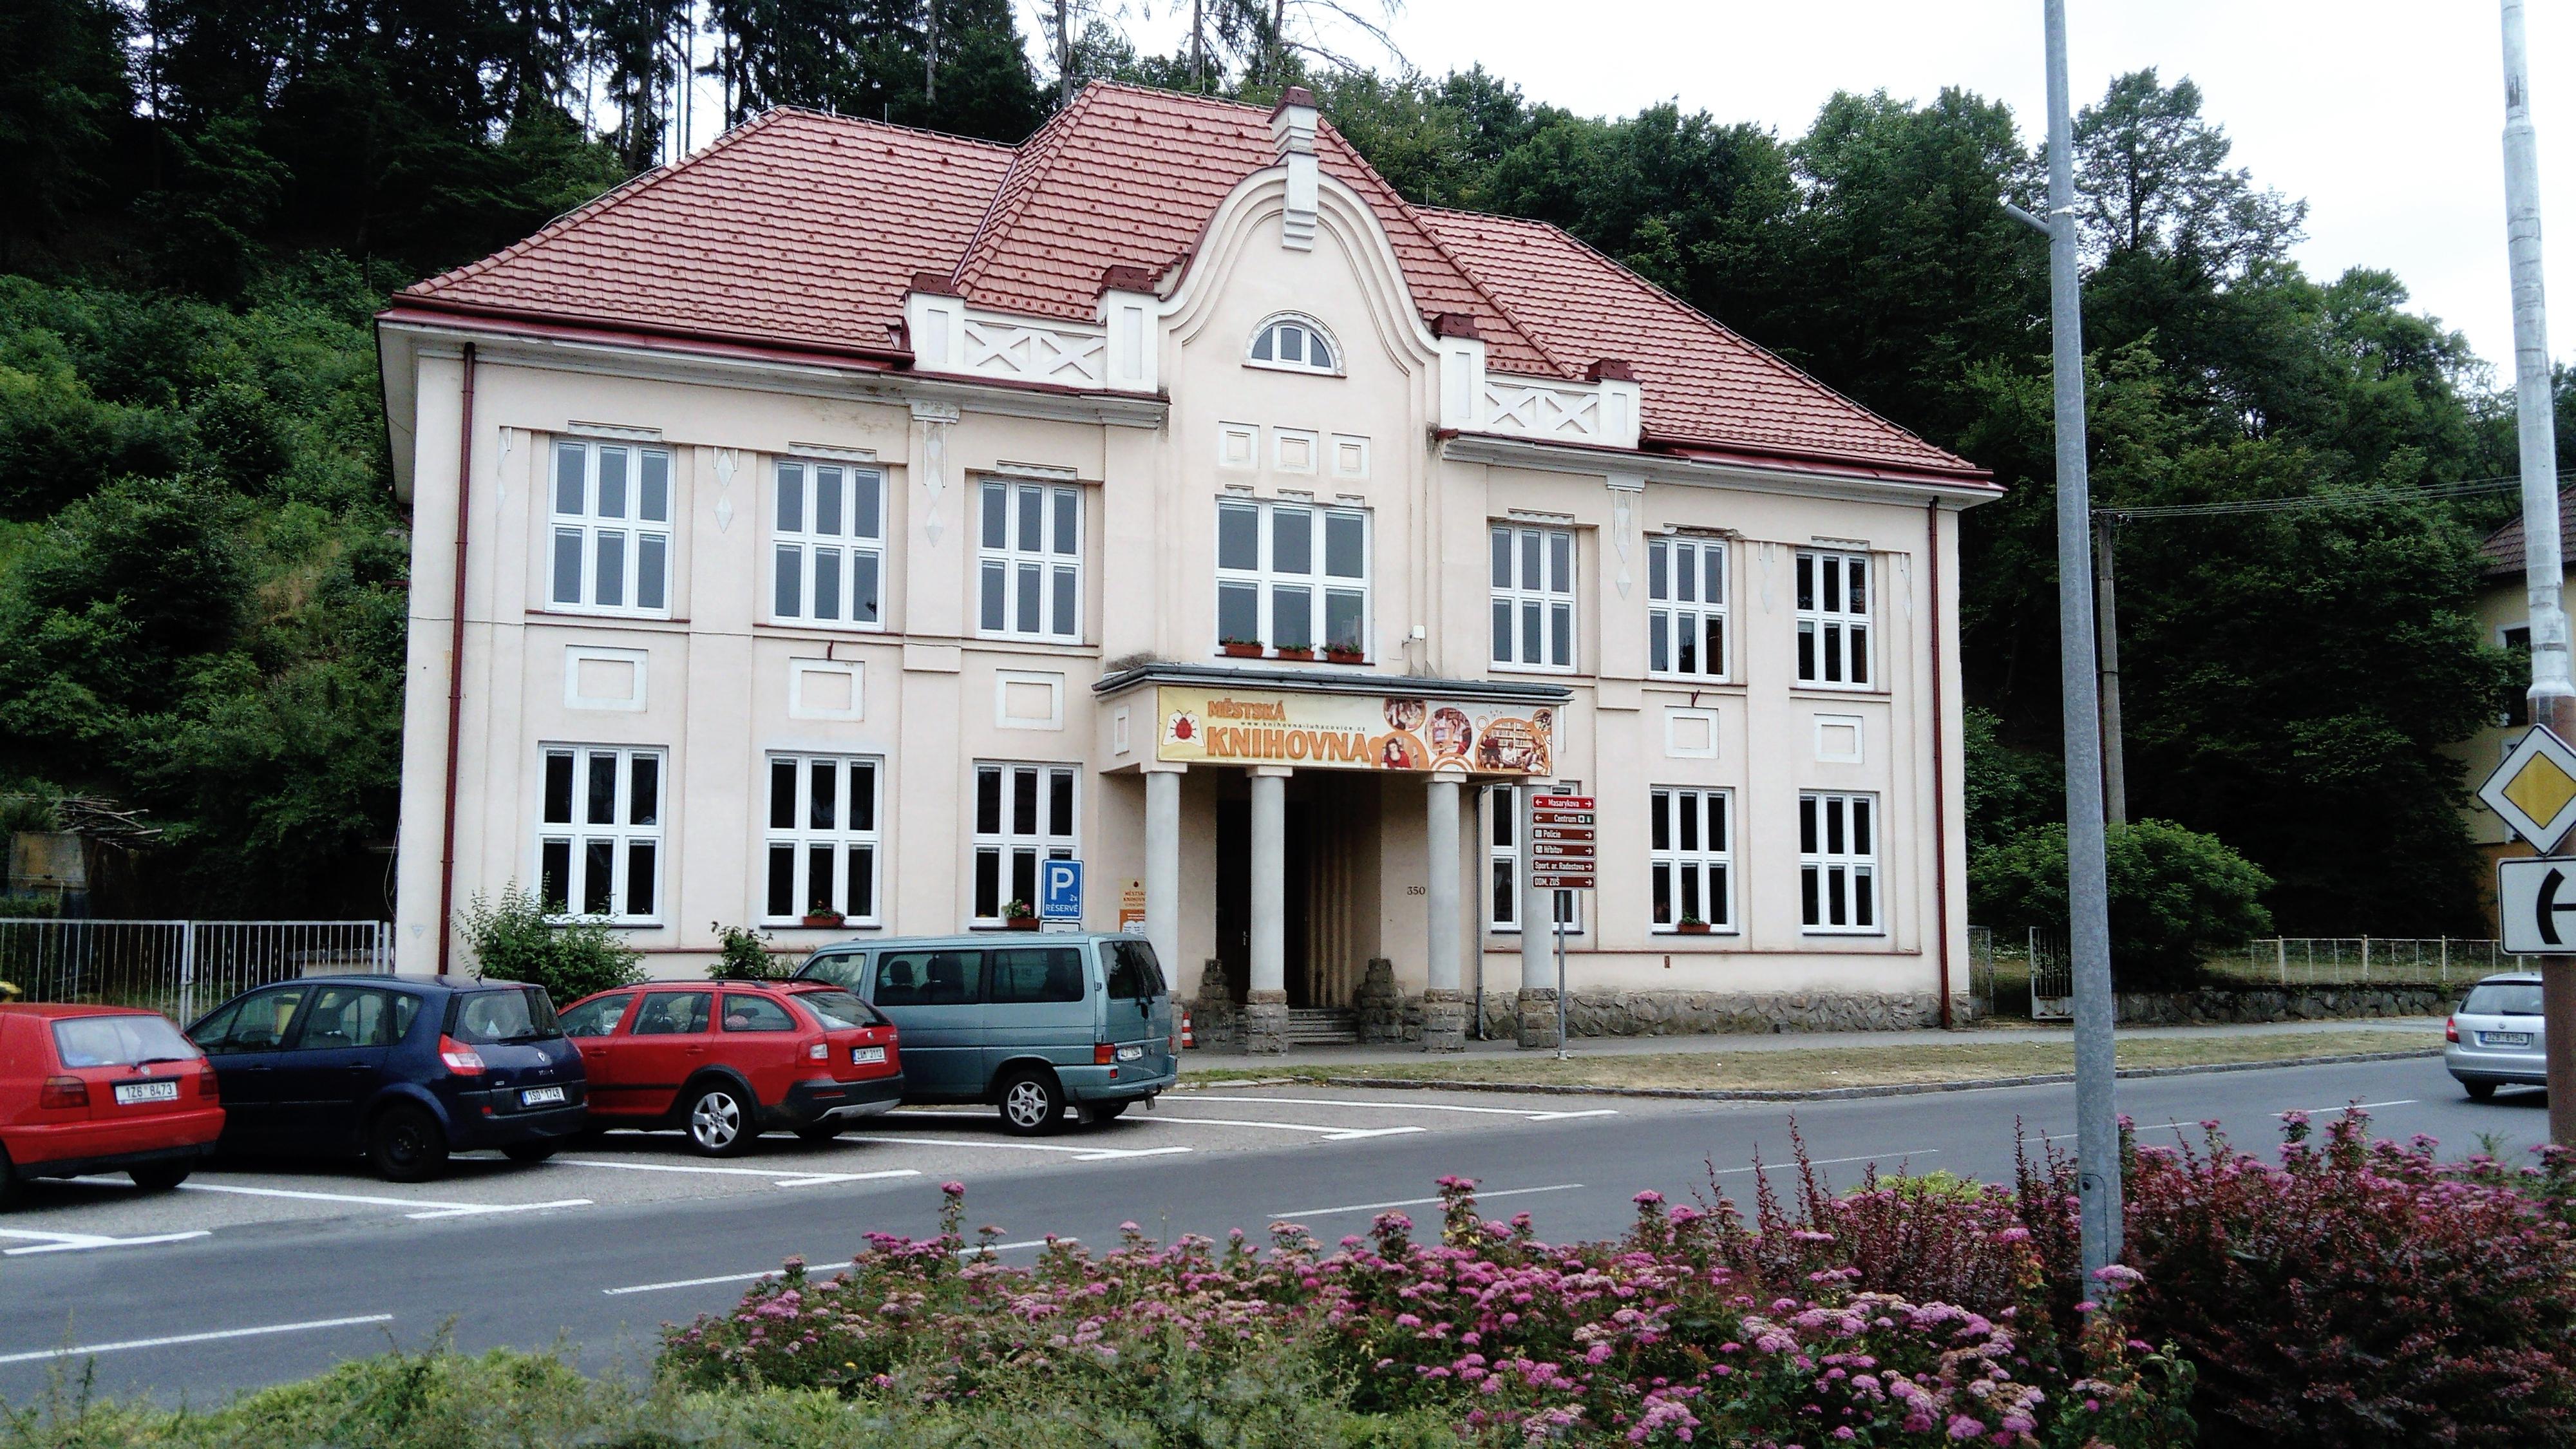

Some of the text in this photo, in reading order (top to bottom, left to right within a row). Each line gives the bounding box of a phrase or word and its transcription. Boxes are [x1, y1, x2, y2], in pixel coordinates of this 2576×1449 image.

[1208, 697, 1286, 721] MĚSTSKÁ
[1207, 726, 1370, 762] KNIHOVNA
[1548, 799, 1580, 808] Masarykova
[1554, 814, 1577, 822] Centrum
[1543, 829, 1561, 838] Policie
[1535, 861, 1550, 870] Sport.
[1051, 867, 1075, 900] P
[1549, 876, 1560, 886] ZUŠ
[1406, 886, 1425, 895] 350
[150, 1084, 172, 1095] 8473
